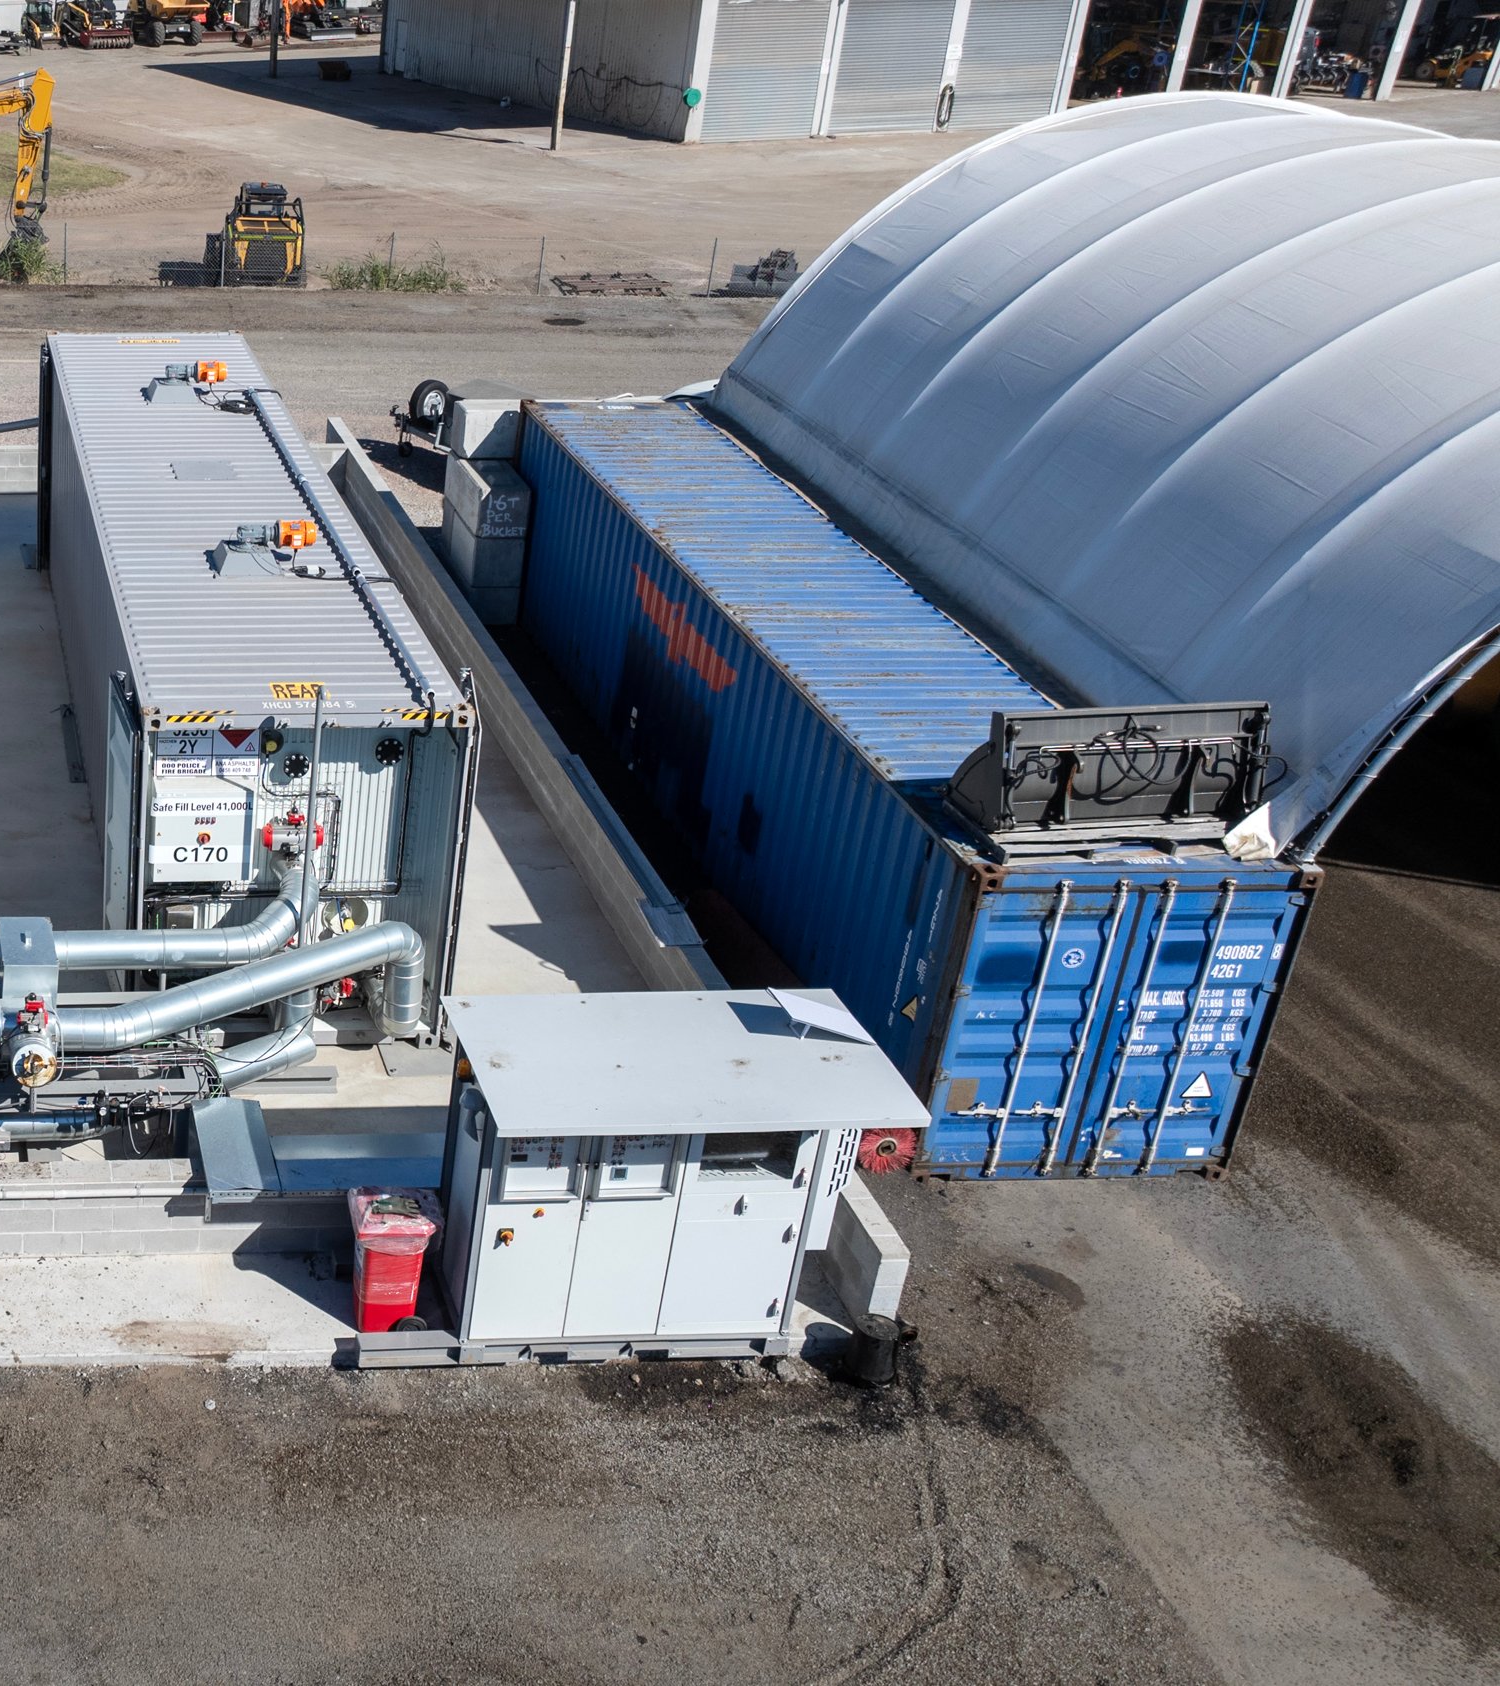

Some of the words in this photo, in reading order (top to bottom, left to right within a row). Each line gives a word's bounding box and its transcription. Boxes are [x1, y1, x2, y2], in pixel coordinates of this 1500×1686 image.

[487, 509, 512, 524] PER
[481, 524, 526, 538] BUCKET
[295, 701, 341, 709] 57684
[179, 739, 198, 754] 2Y
[153, 803, 173, 812] Safe
[175, 802, 189, 811] Fill
[191, 802, 214, 811] Level
[216, 802, 253, 812] 41,000L
[173, 847, 228, 862] C170
[1215, 945, 1263, 960] 490862
[1271, 944, 1283, 959] 8
[1210, 964, 1242, 978] 42G1
[1162, 991, 1185, 1005] GROSS
[1232, 989, 1247, 997] KGS
[1231, 999, 1245, 1007] LBS
[1221, 1033, 1235, 1041] LBS
